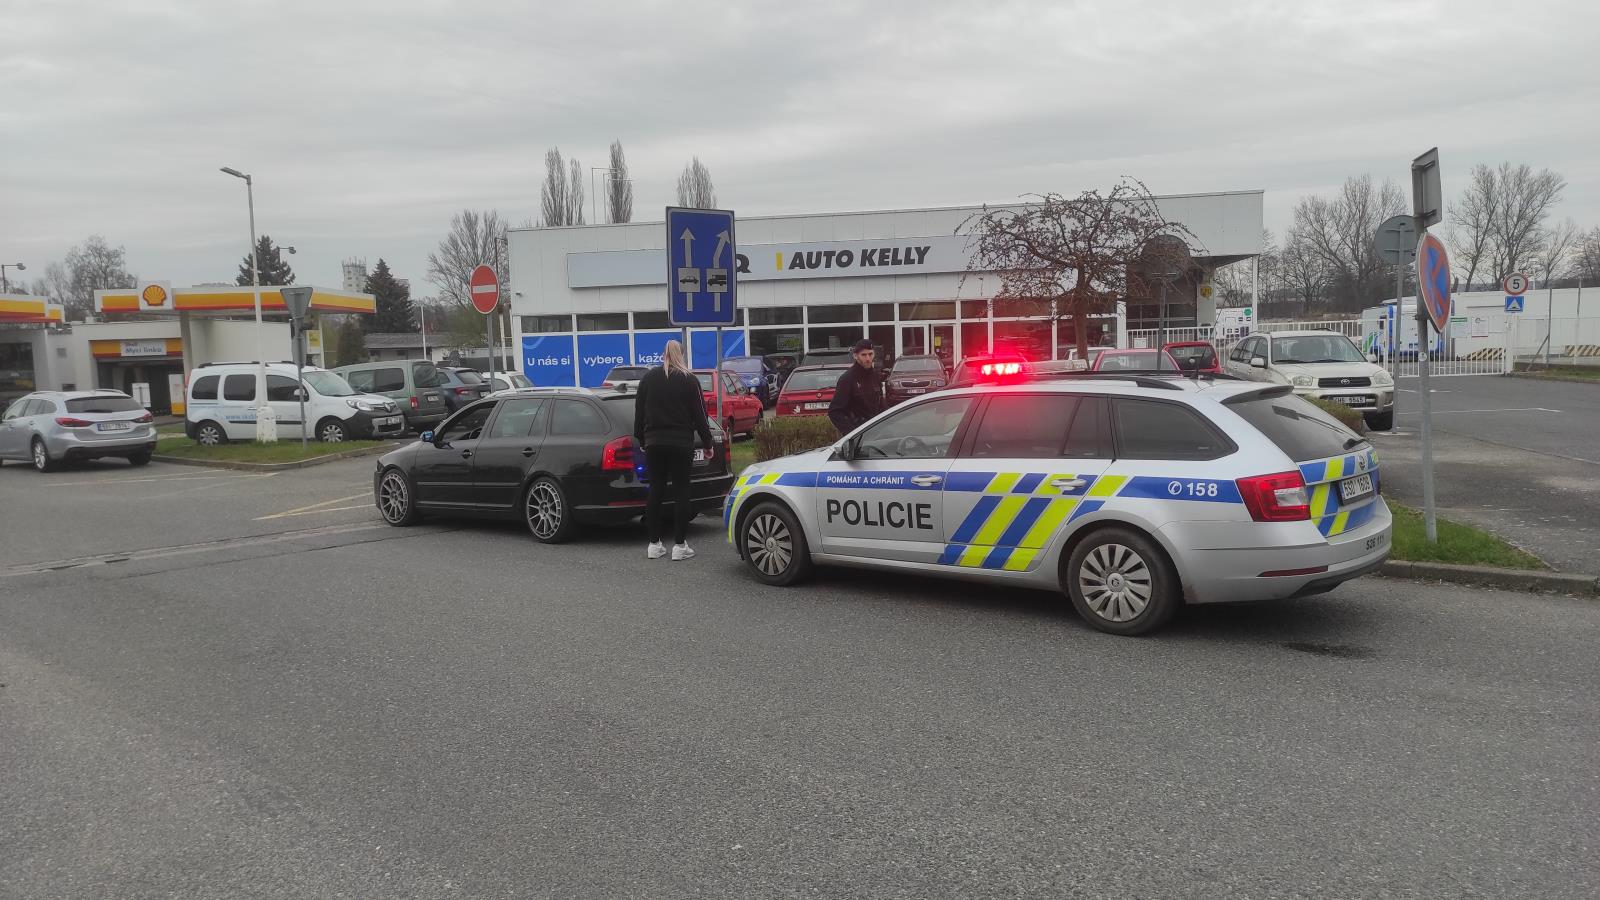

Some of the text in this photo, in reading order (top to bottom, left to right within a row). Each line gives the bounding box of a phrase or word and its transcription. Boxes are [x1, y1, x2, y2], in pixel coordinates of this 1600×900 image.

[789, 249, 854, 270] AUTO
[860, 246, 931, 267] KELLY
[1512, 279, 1520, 290] 5
[527, 355, 571, 366] U nás si
[583, 355, 624, 367] vybere
[826, 474, 904, 485] POMÁHAT A CHRÁNIT
[1187, 482, 1218, 497] 158
[826, 499, 933, 529] POLICIE
